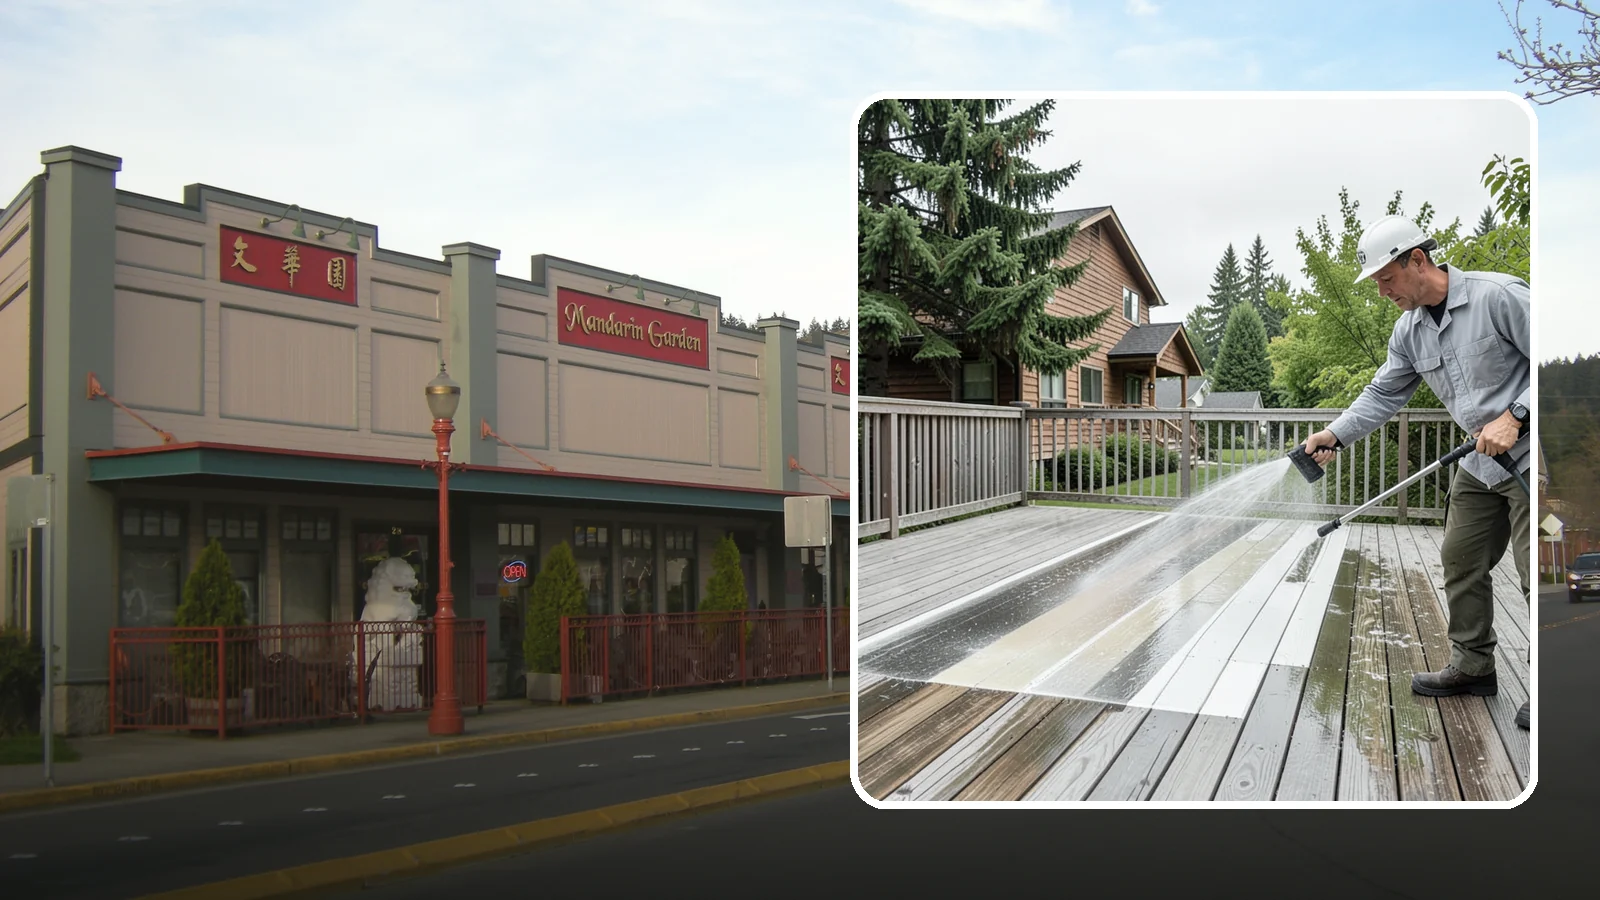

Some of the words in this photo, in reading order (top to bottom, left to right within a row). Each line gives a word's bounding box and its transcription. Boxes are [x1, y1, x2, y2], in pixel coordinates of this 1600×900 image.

[230, 235, 346, 291] 文華園
[564, 302, 644, 341] Mandarin
[648, 320, 702, 352] Garden
[503, 565, 527, 578] OPEN
